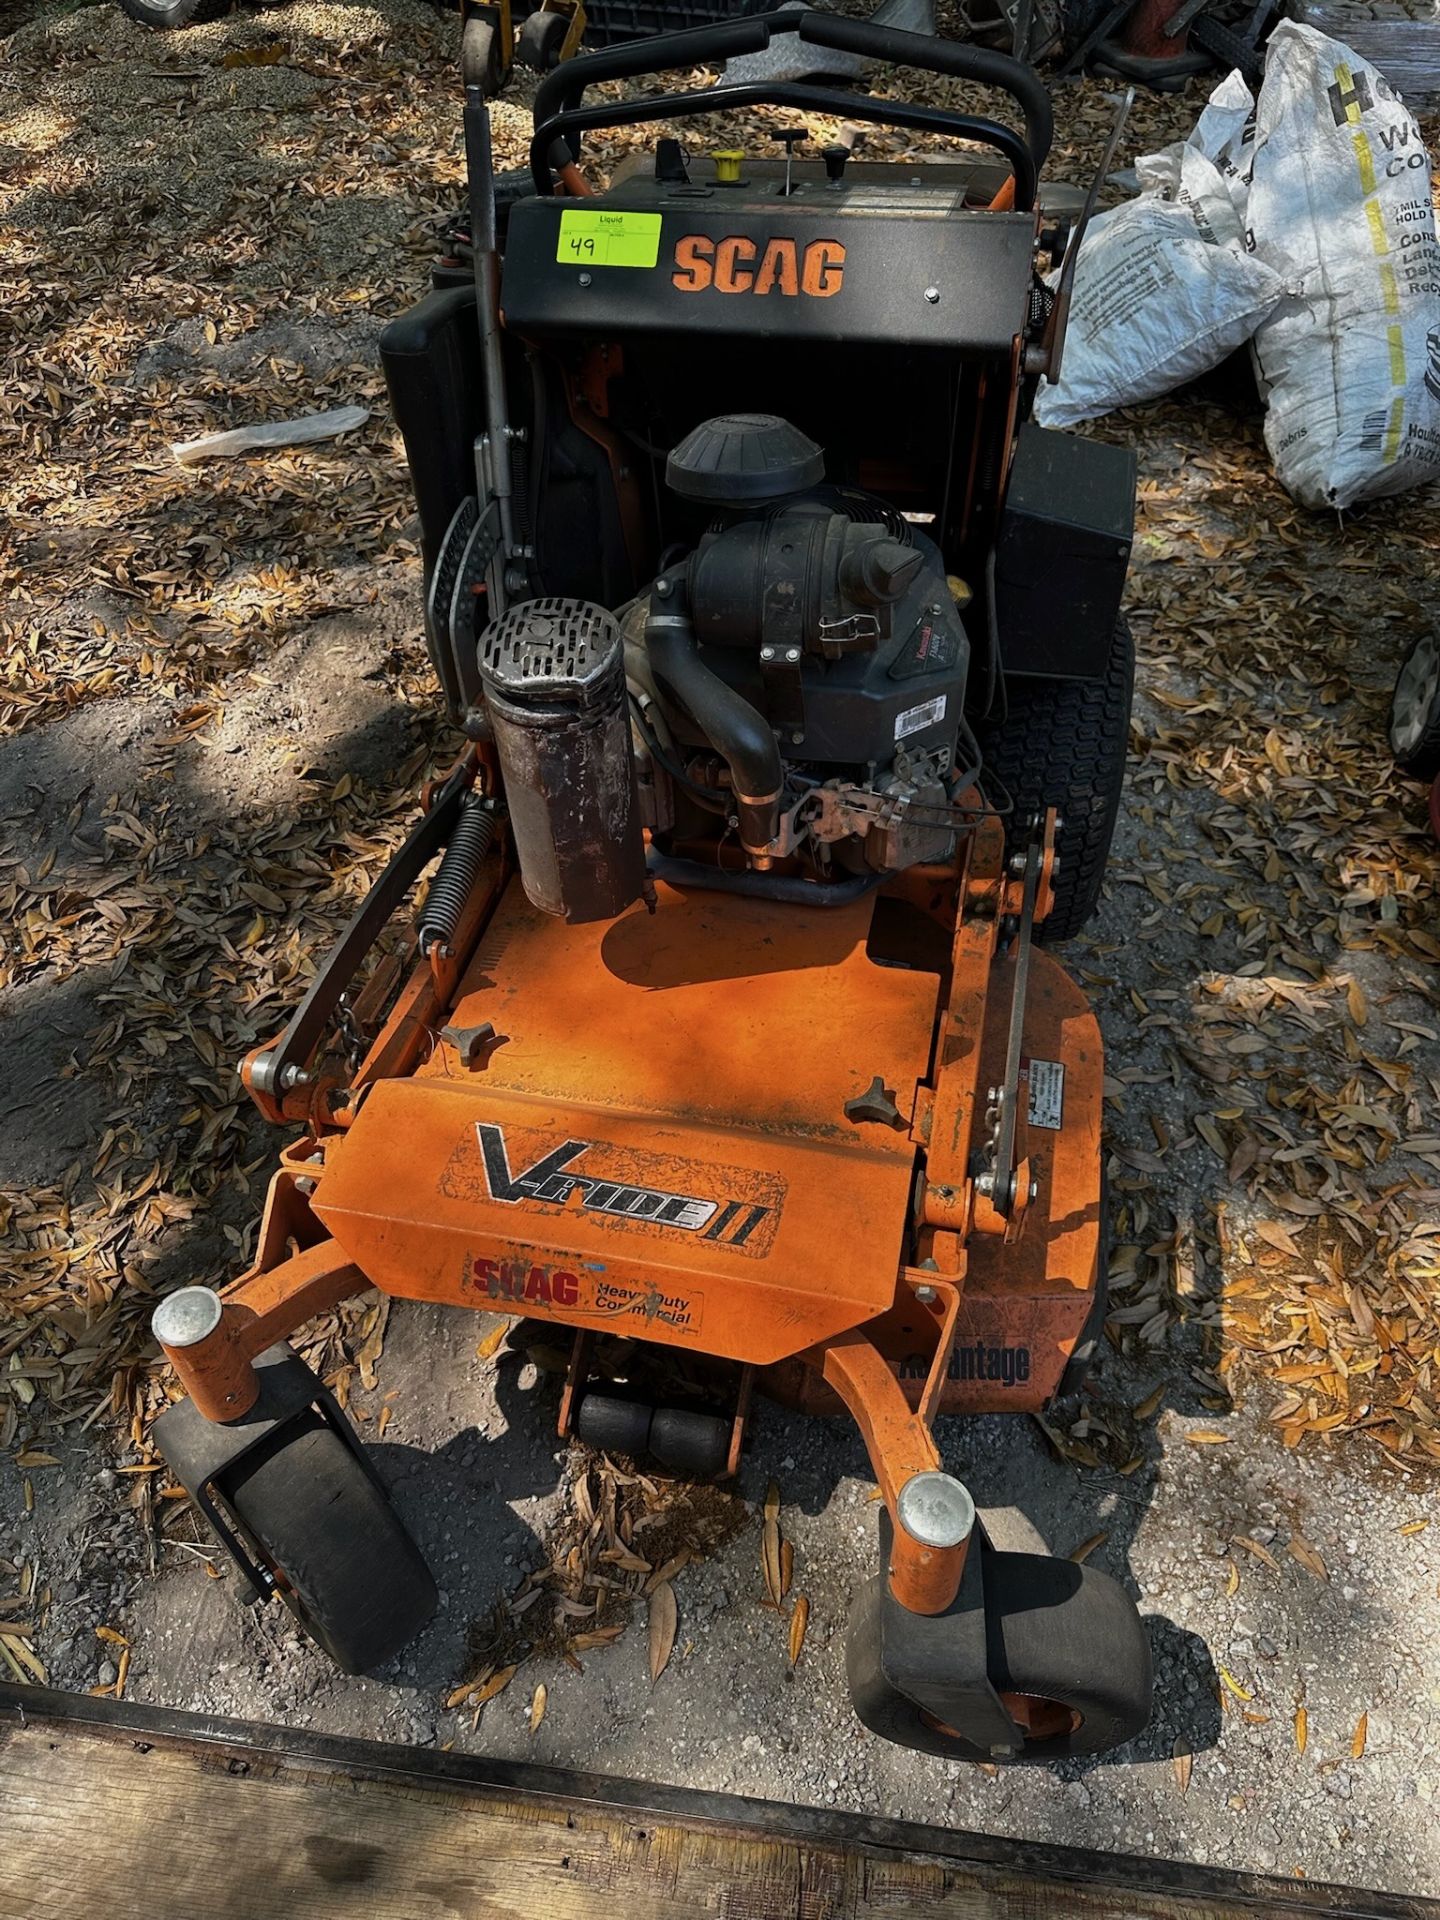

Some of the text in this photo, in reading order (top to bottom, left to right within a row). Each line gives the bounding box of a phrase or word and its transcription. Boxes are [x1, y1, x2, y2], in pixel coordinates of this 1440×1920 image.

[1400, 200, 1421, 212] MIL
[599, 216, 623, 224] Liquid
[1396, 210, 1427, 225] HOLD
[571, 238, 594, 256] 49
[671, 233, 847, 298] SCAG
